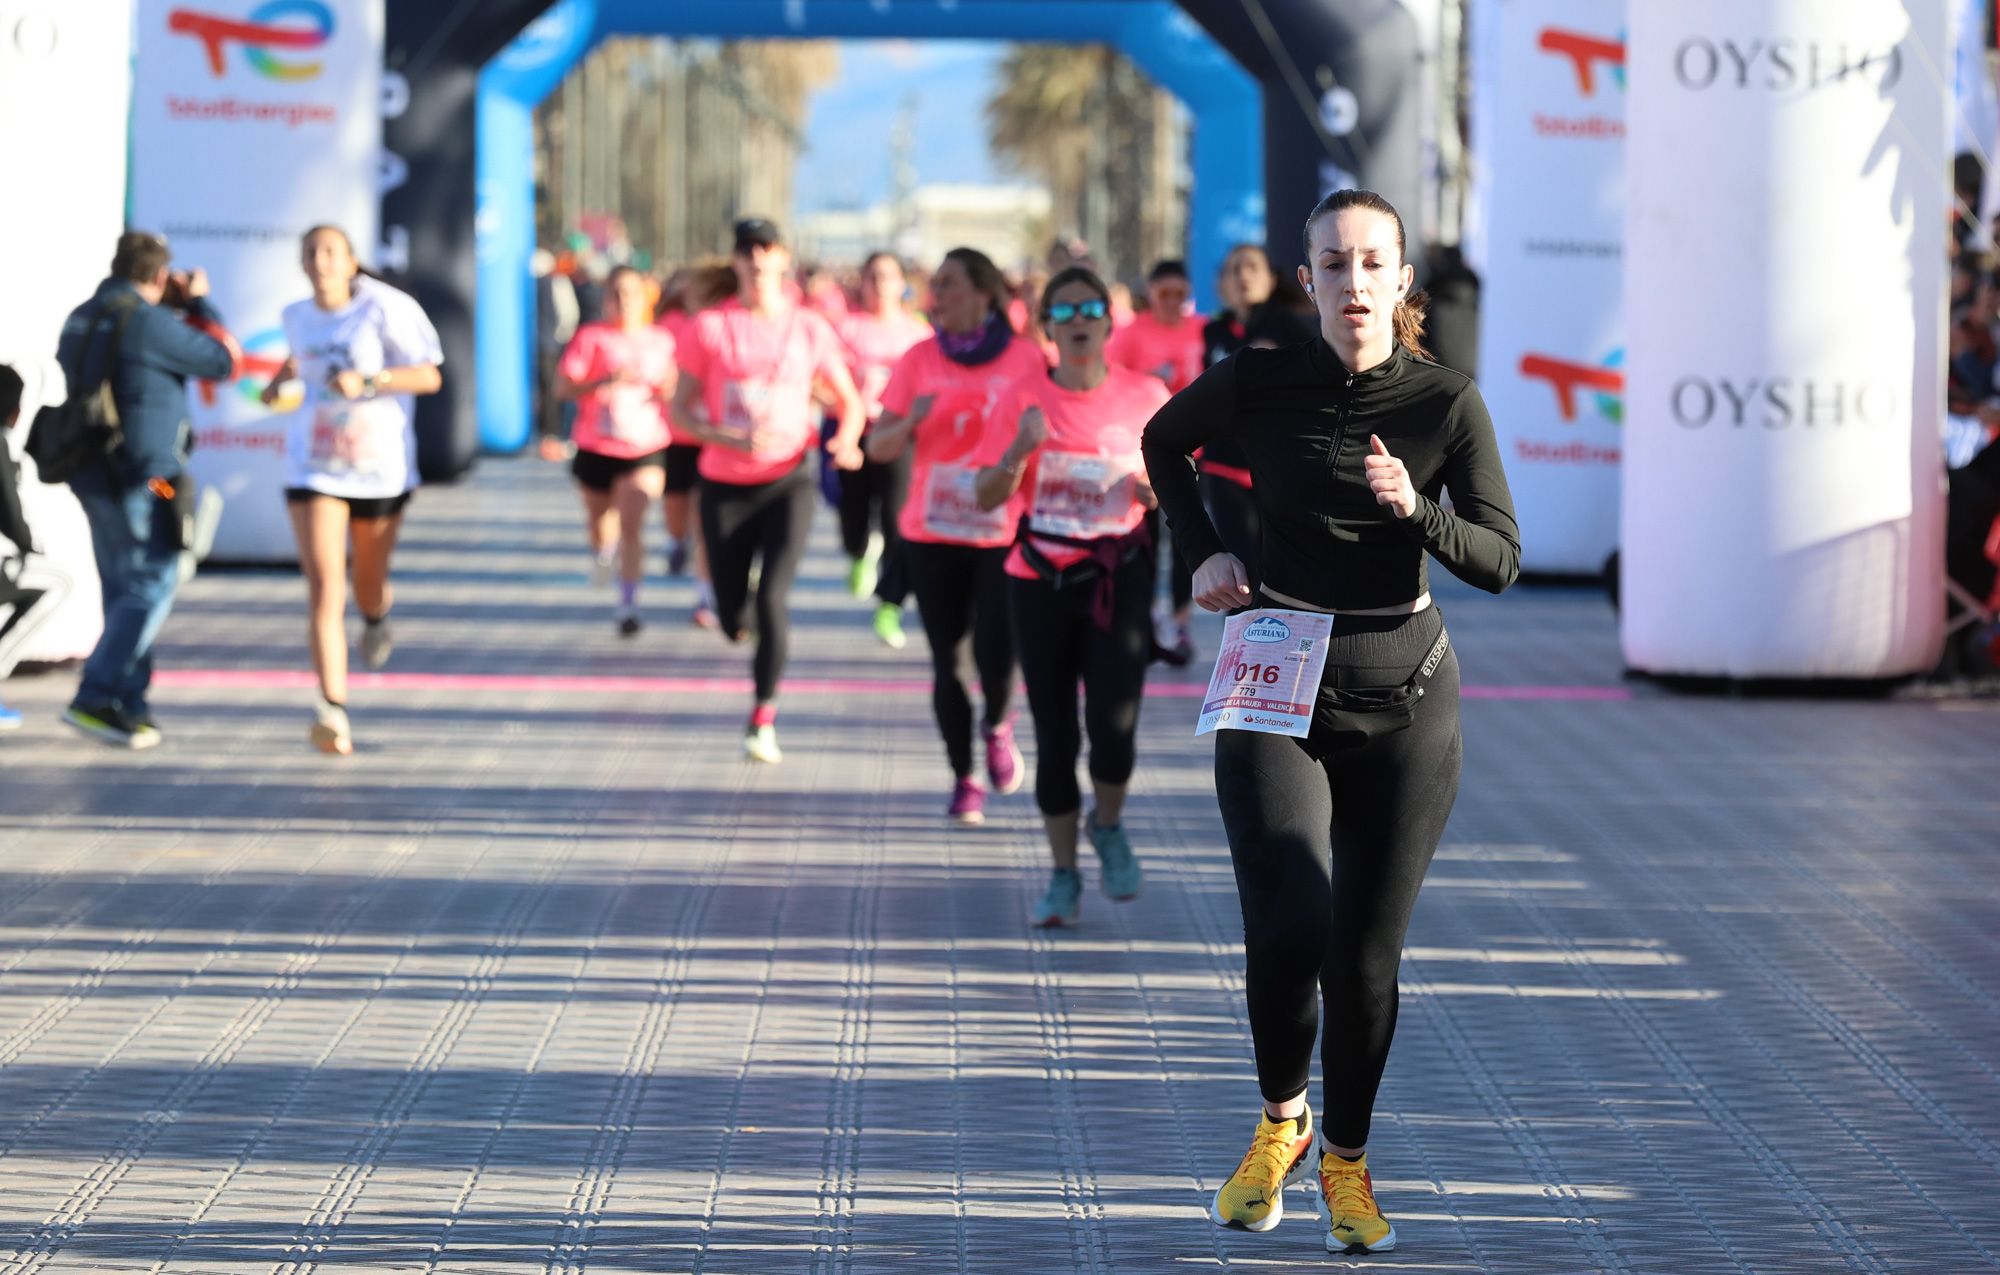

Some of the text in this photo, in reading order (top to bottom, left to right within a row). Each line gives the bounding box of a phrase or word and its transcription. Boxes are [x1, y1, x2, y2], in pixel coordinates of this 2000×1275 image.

[1670, 373, 1897, 431] OYSHO
[1233, 662, 1281, 685] 016
[1239, 686, 1256, 697] 779
[1240, 699, 1262, 708] MUJER
[1266, 701, 1296, 713] VALENCIA
[1253, 716, 1295, 729] Santander
